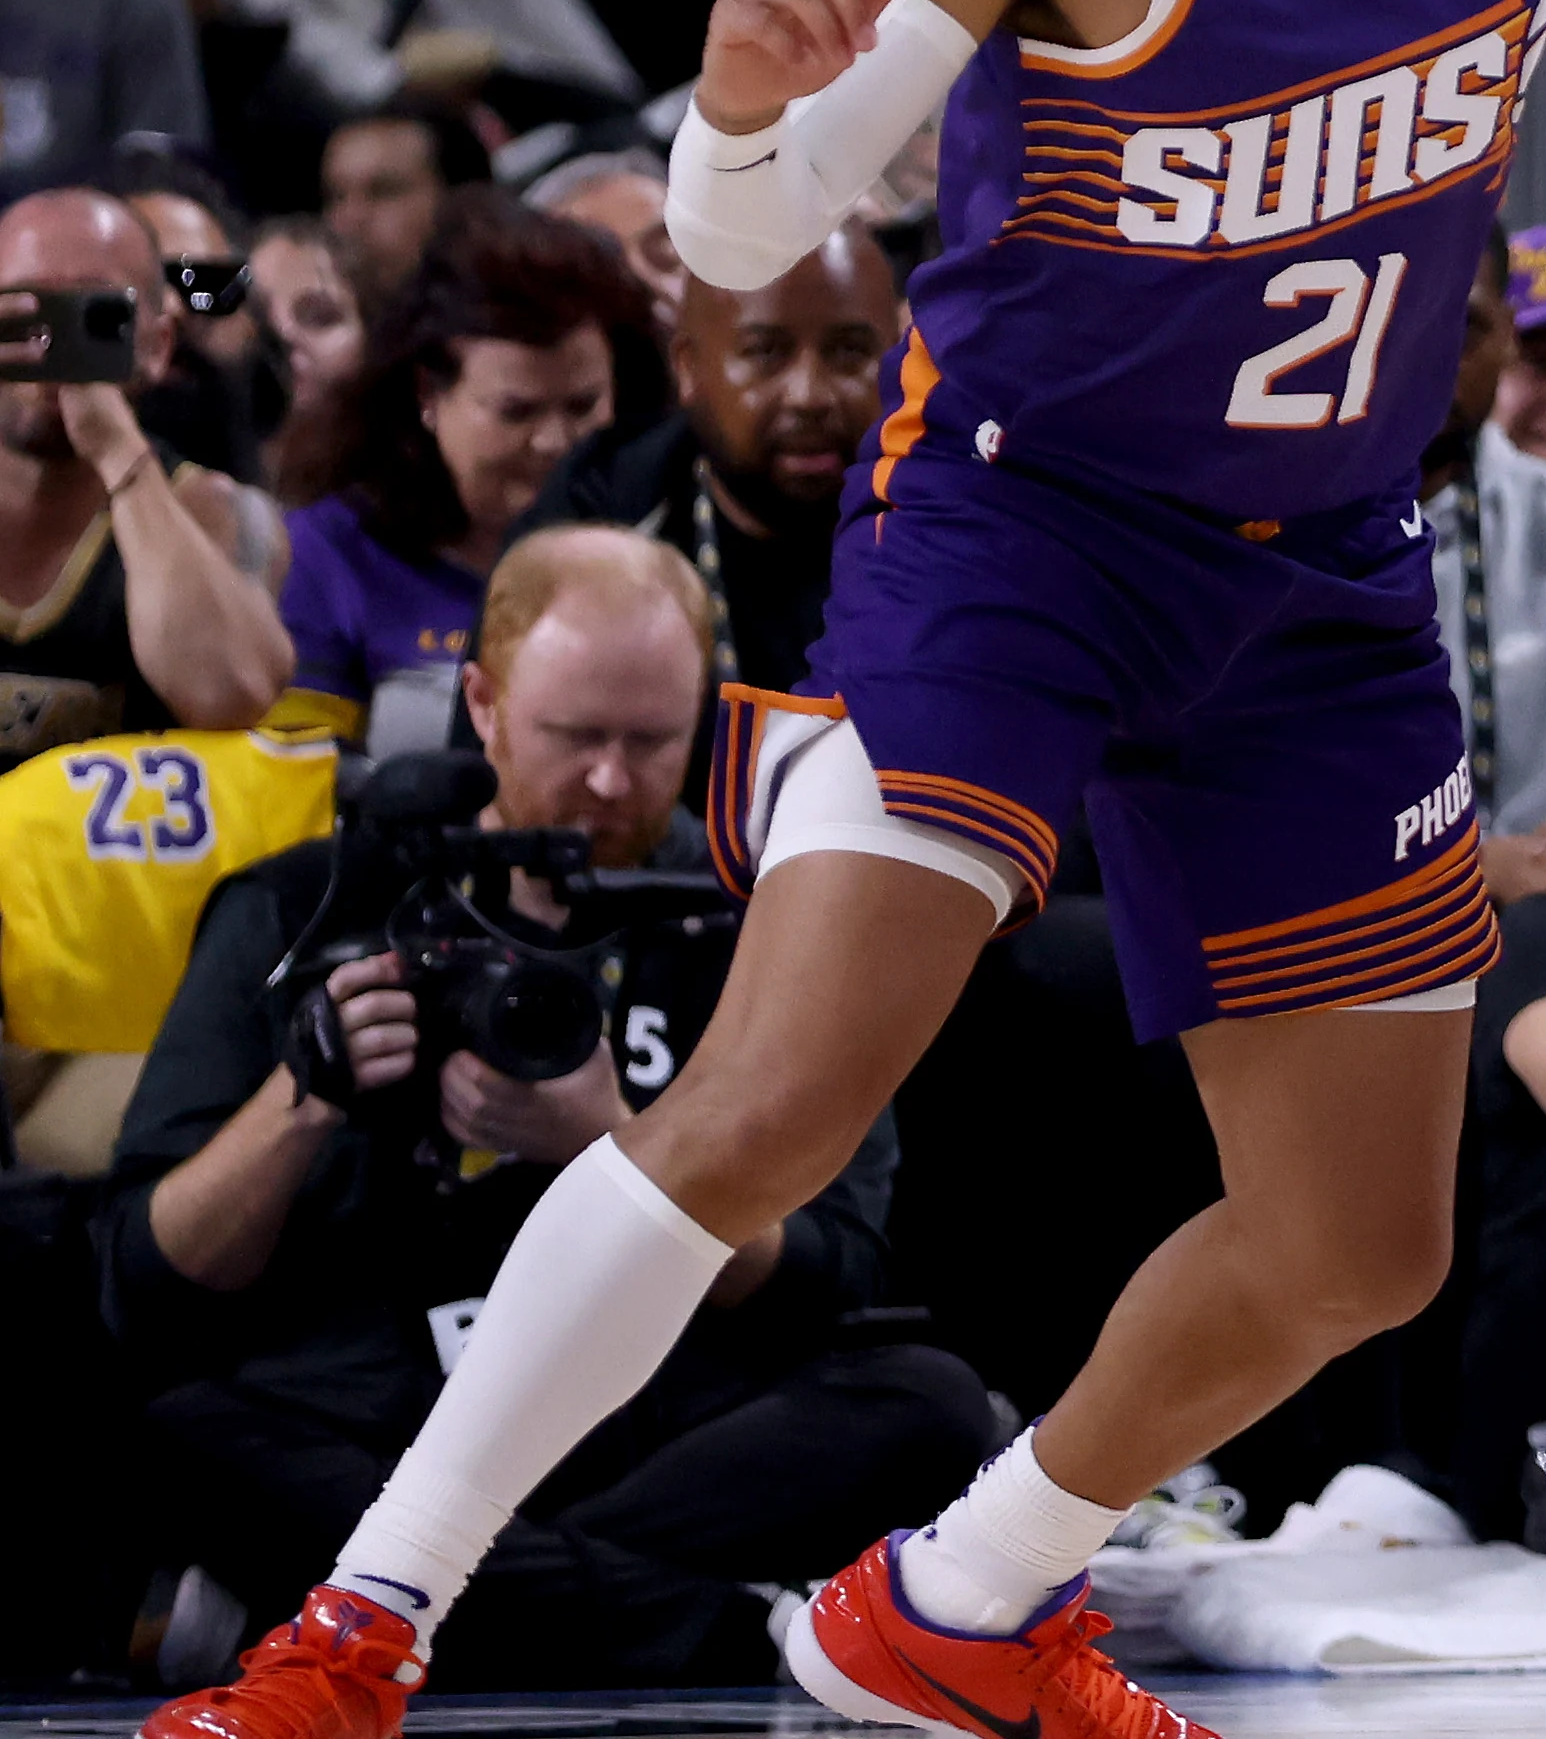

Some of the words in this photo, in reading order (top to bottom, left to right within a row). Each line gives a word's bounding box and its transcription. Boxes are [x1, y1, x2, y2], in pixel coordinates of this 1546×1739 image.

[1225, 252, 1408, 429] 21
[61, 745, 216, 865] 23
[625, 1005, 675, 1089] 5
